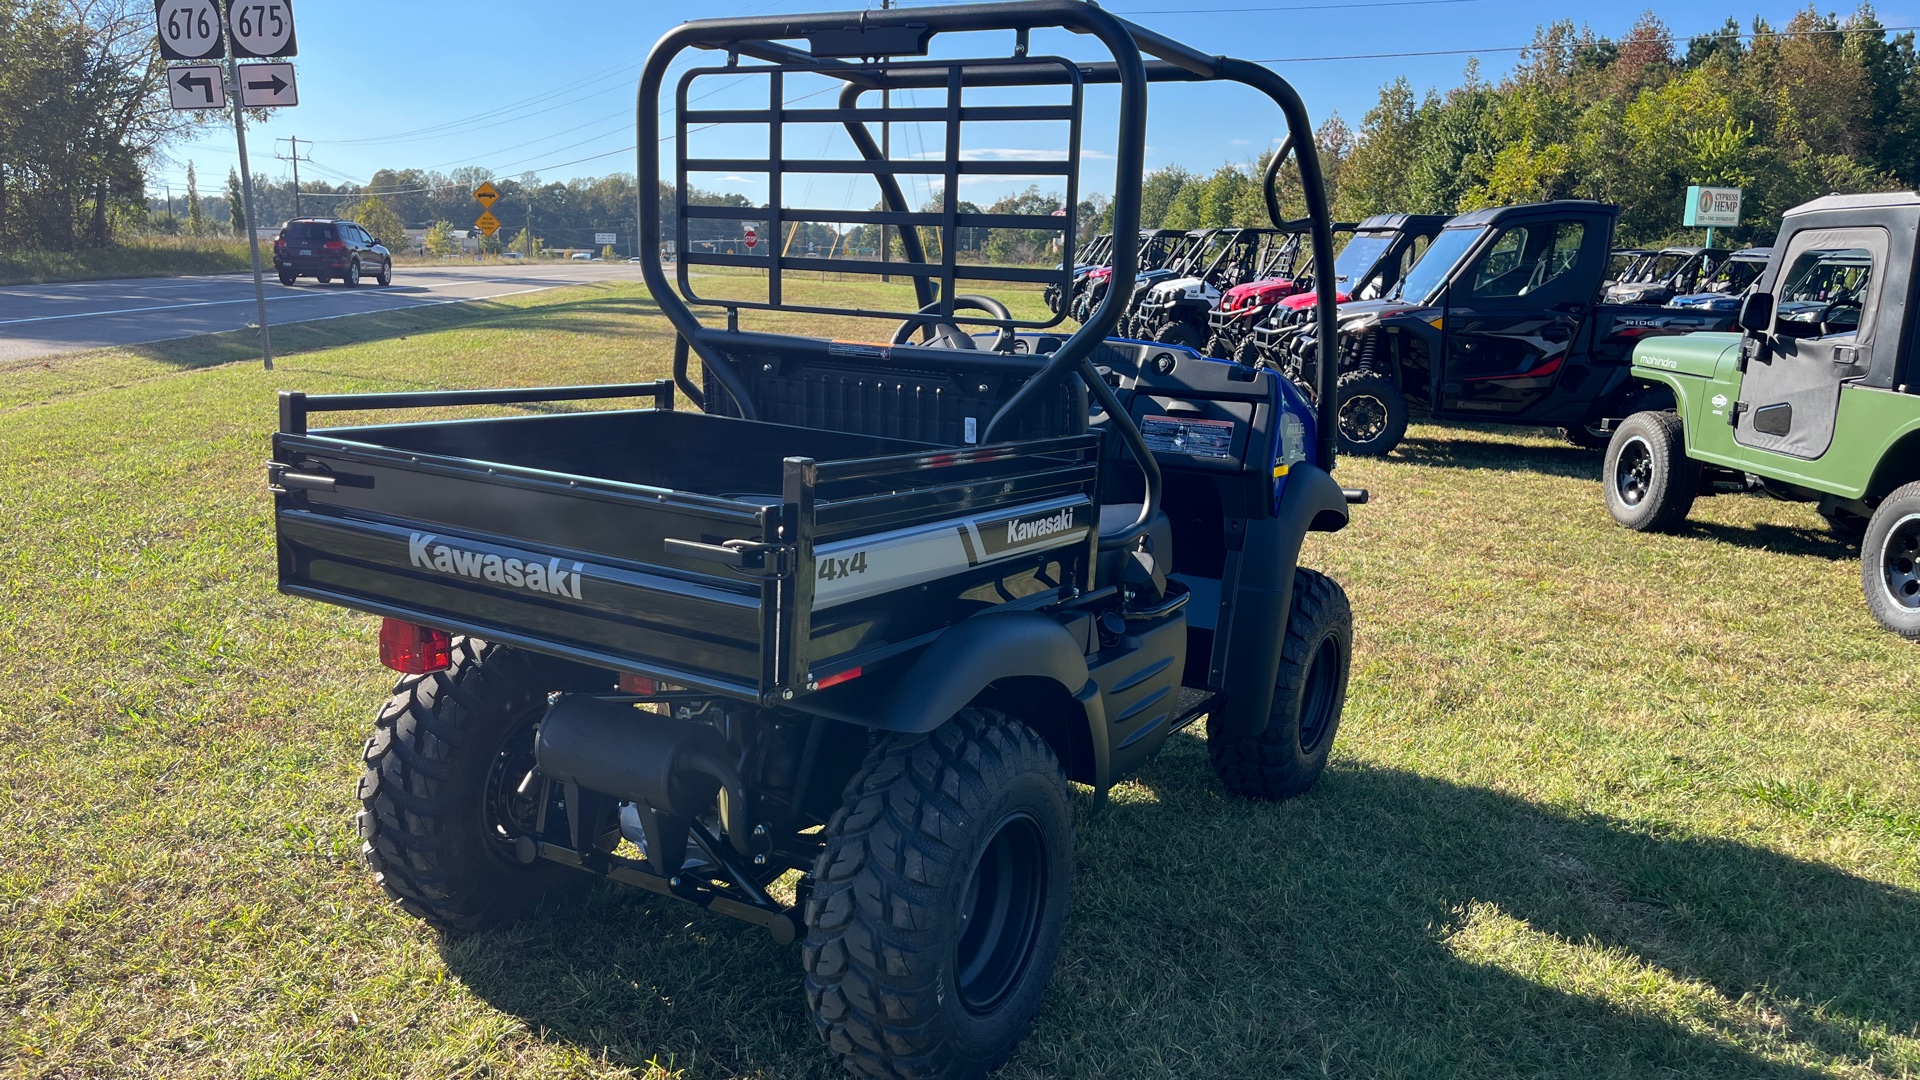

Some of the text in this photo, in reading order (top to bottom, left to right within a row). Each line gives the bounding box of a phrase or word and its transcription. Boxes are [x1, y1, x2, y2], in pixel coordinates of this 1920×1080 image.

[168, 7, 210, 40] 676
[239, 5, 283, 38] 675
[1714, 201, 1738, 212] HEMP
[1715, 193, 1739, 201] CYPRESS
[1640, 355, 1677, 369] mahindra
[1457, 400, 1502, 410] Kawasaki
[1007, 508, 1073, 543] Kawasaki
[409, 532, 585, 600] Kawasaki
[818, 551, 868, 581] 4x4
